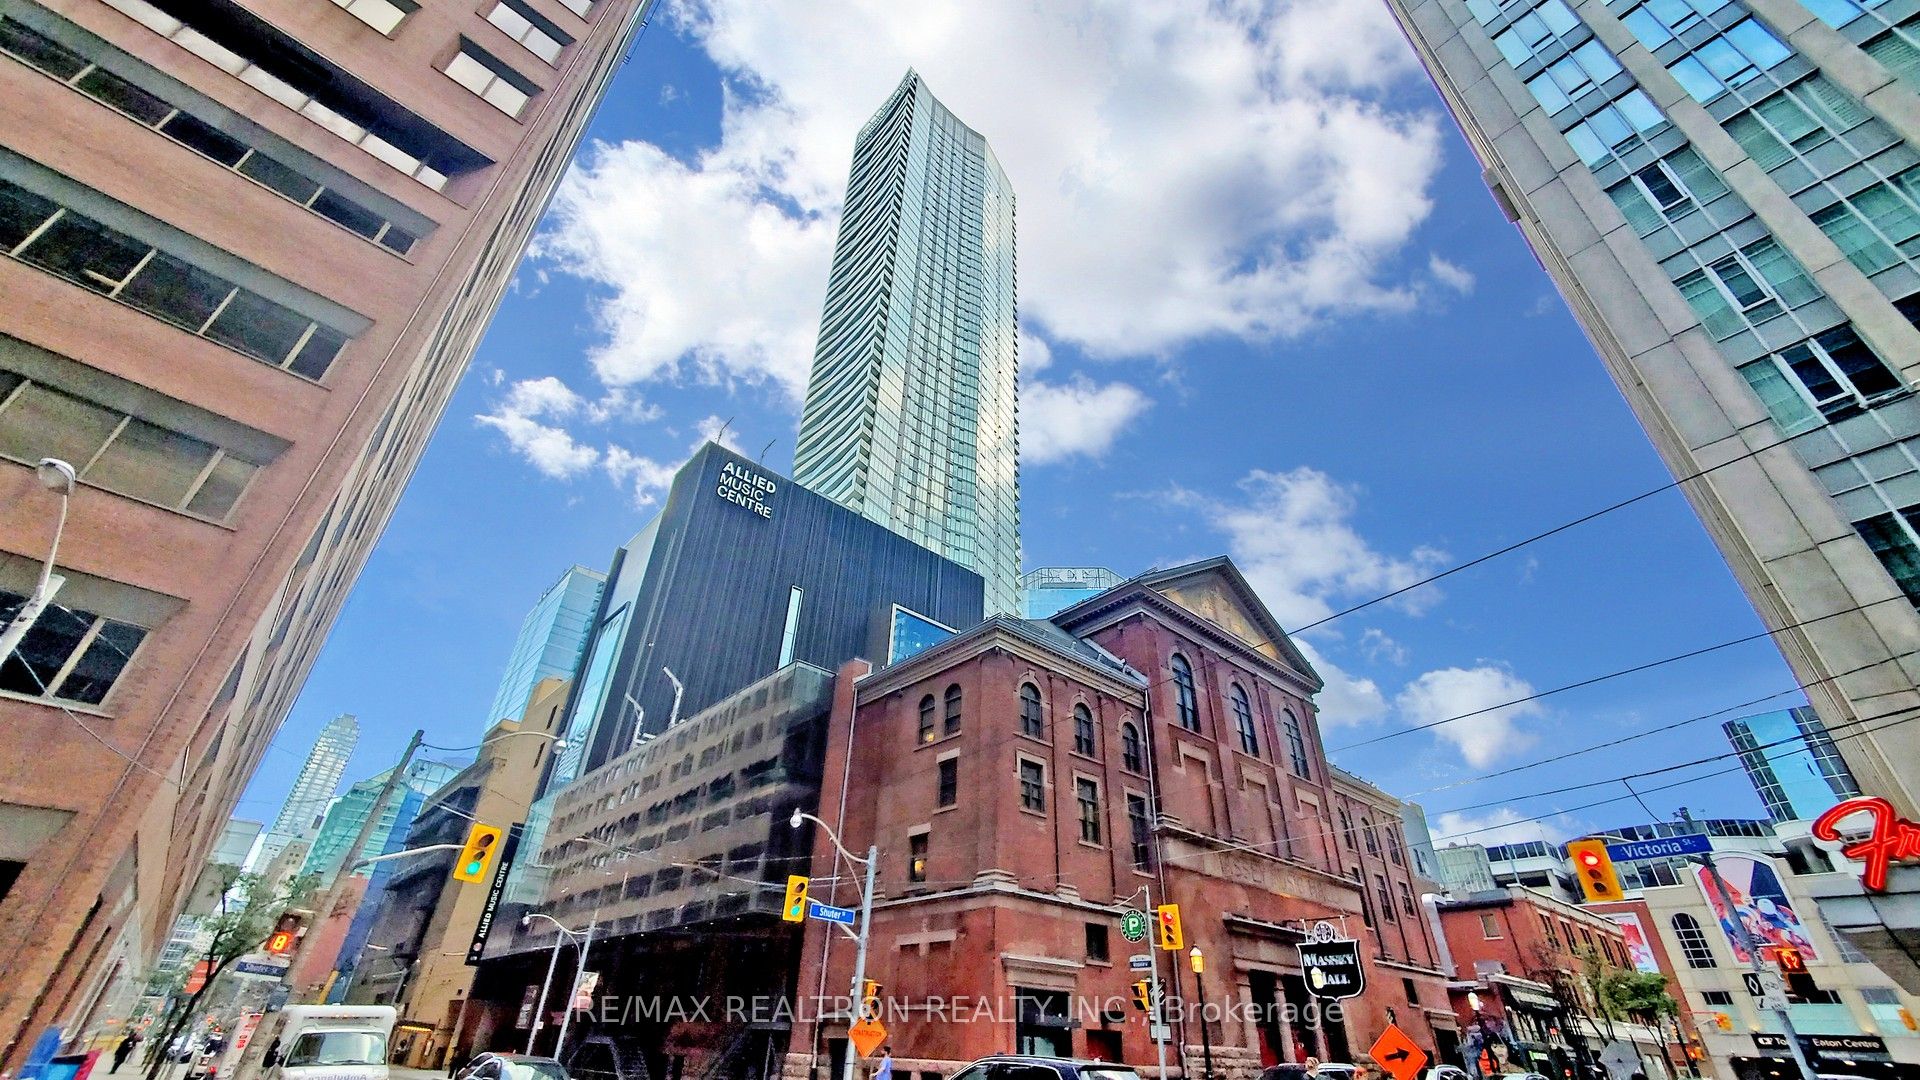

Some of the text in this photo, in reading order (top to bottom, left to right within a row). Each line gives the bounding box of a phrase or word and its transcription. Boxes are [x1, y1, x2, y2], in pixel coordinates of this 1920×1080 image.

[723, 462, 776, 493] ALLIED
[720, 473, 764, 501] MUSIC
[717, 485, 772, 519] CENTRE
[1622, 841, 1682, 858] Victoria
[478, 862, 508, 938] ALLIED MUSIC CENTRE
[819, 907, 841, 919] Shuter
[1128, 917, 1139, 931] P
[1303, 953, 1354, 967] MASSEY
[1812, 1038, 1842, 1047] Eaton
[1844, 1039, 1880, 1049] Centre
